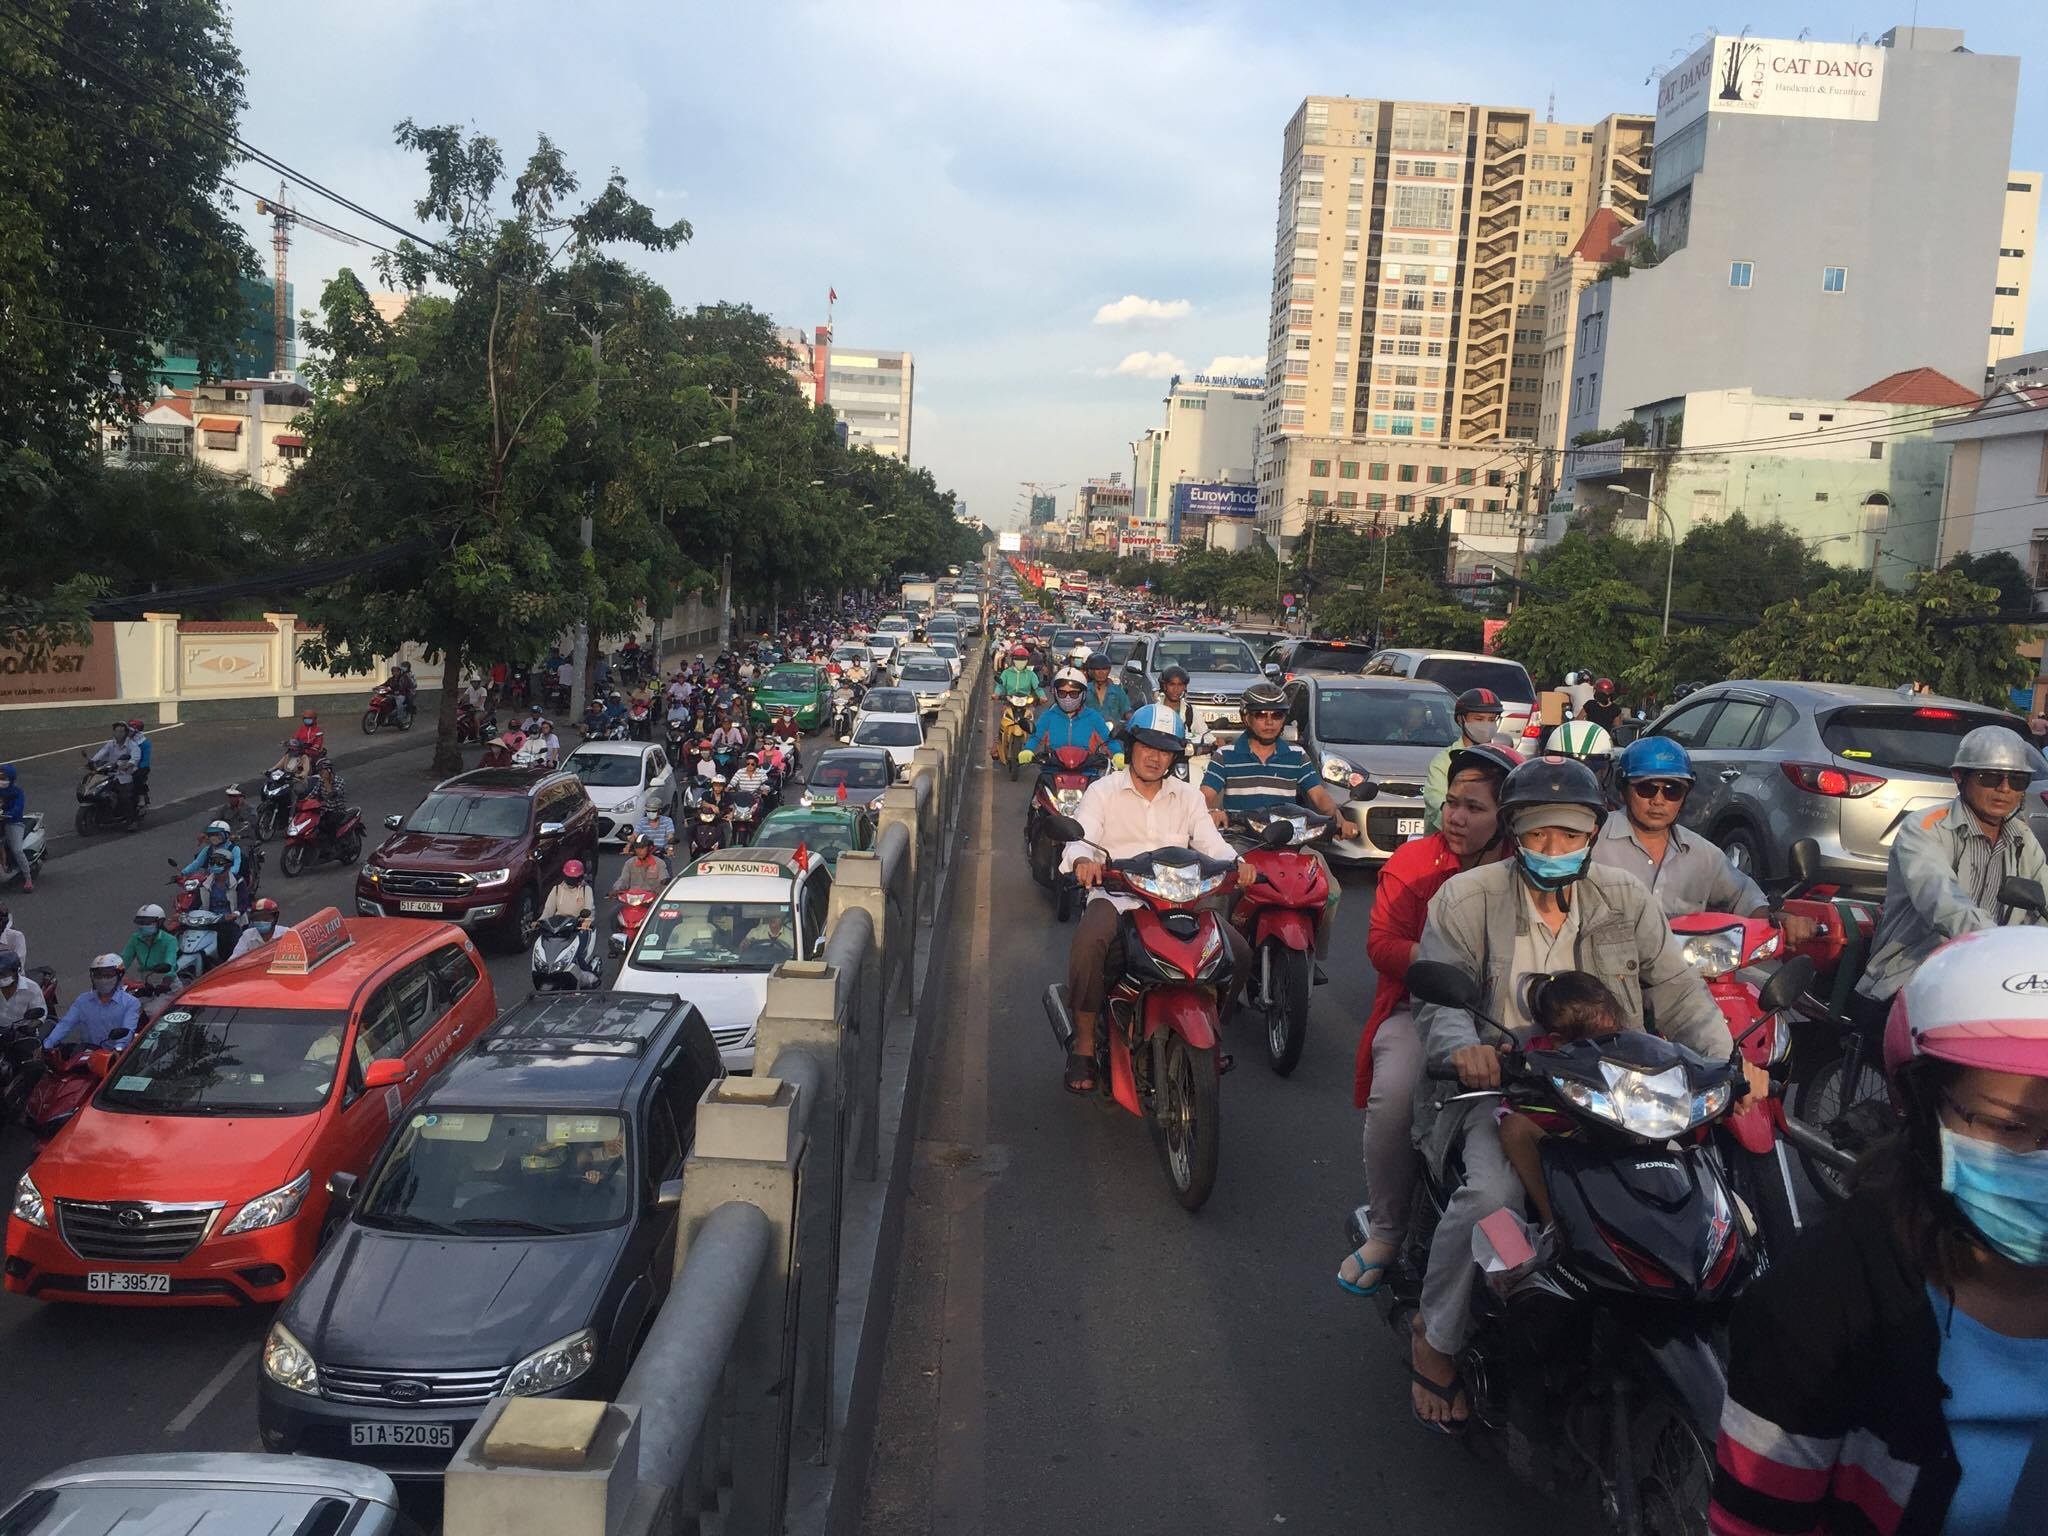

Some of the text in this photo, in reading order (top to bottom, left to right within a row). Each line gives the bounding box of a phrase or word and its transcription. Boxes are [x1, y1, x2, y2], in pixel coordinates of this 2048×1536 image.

[1773, 57, 1873, 78] CAT DANG
[1818, 84, 1826, 94] &
[1634, 1161, 1680, 1171] HONDA
[90, 1273, 168, 1291] 51F-395.72
[353, 1424, 450, 1446] 51A-520.95
